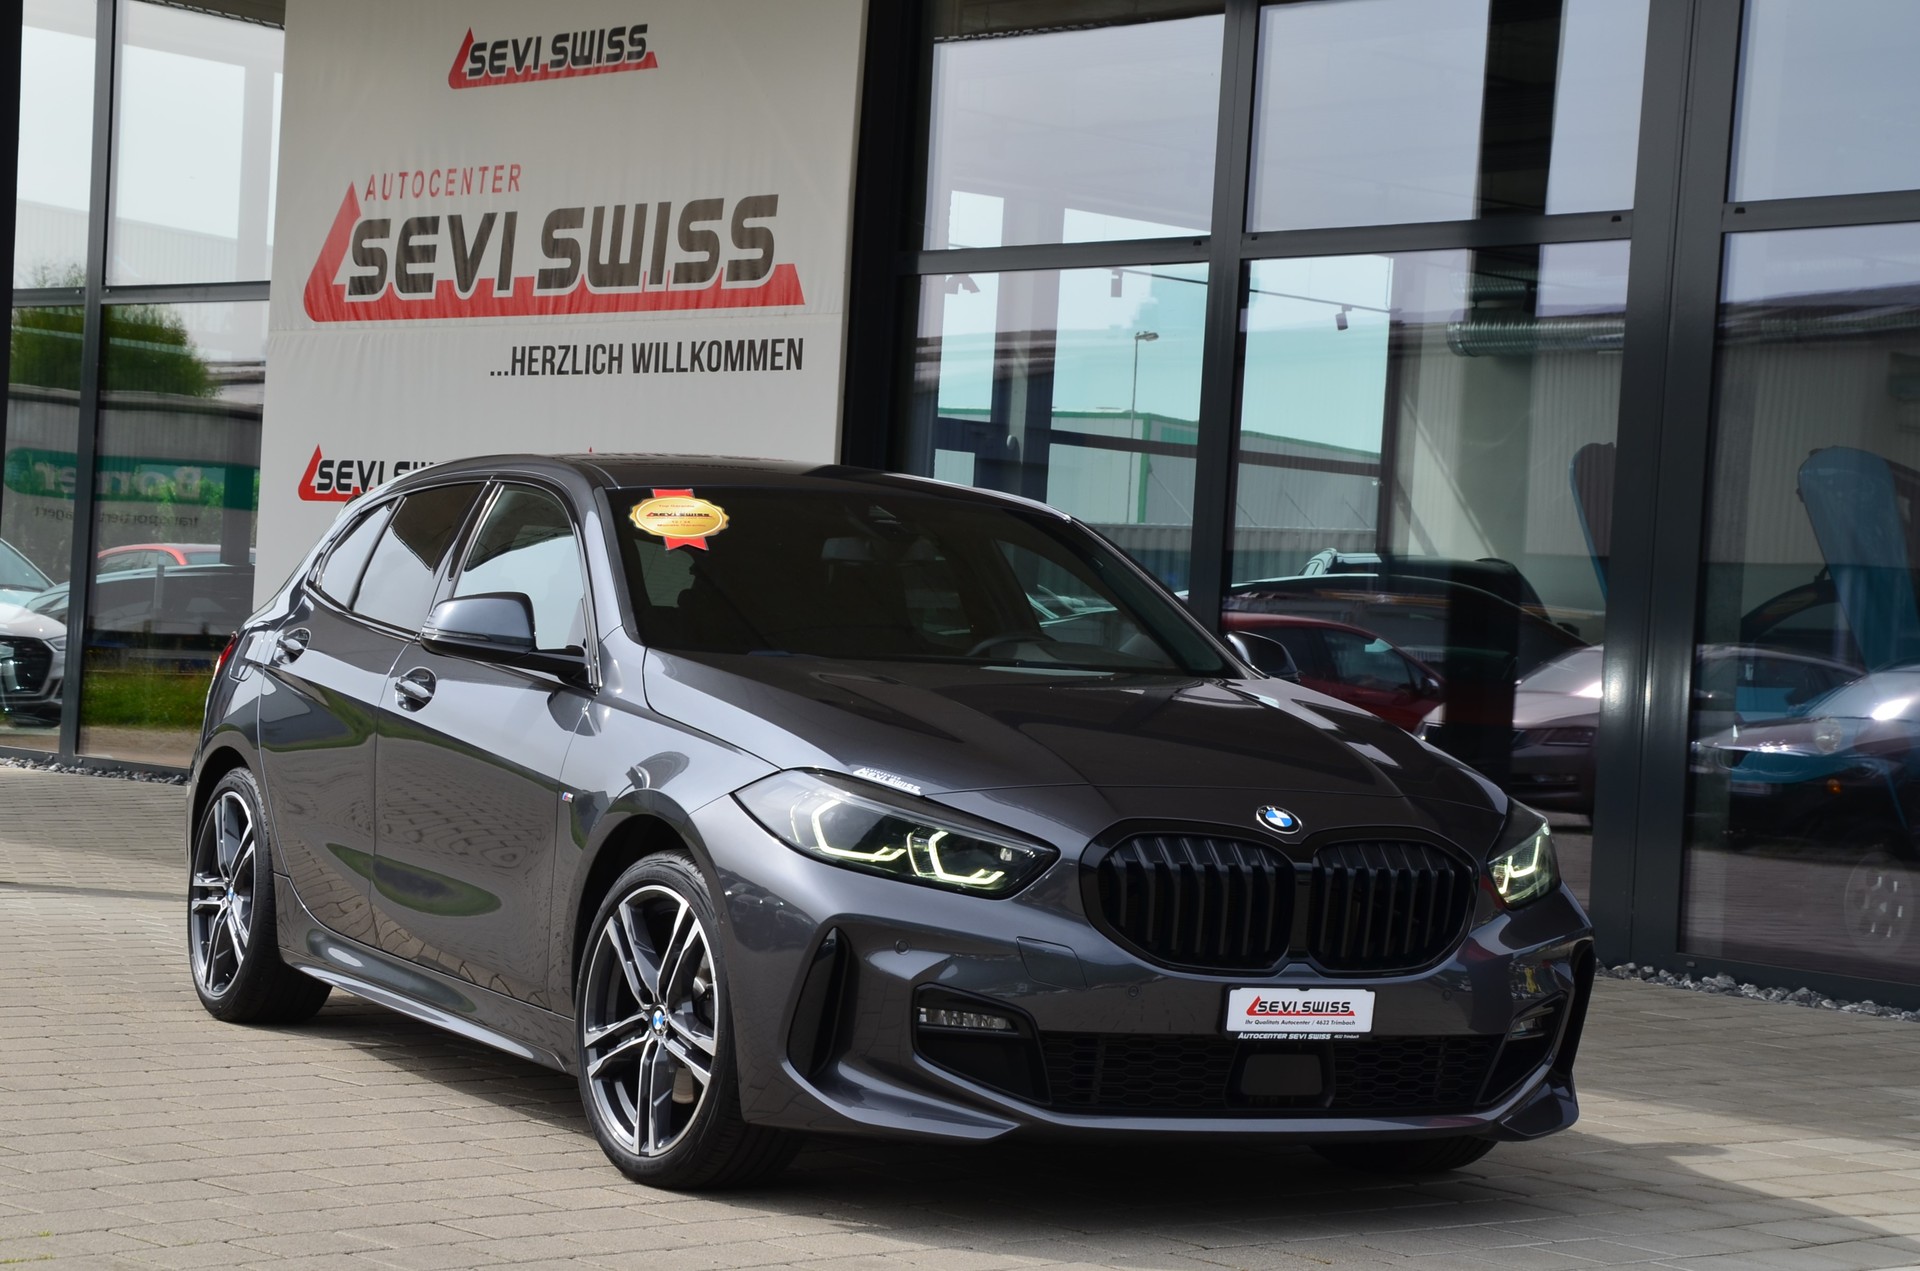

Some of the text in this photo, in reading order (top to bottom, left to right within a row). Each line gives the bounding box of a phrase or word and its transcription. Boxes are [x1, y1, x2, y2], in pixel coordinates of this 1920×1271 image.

[467, 23, 648, 77] SEVI SWISS
[364, 163, 522, 201] AUTOCENTER
[348, 194, 779, 296] SEVI SWISS
[489, 337, 804, 377] ...HERZLICH WILLKOMMEN
[316, 459, 385, 492] SEVI
[1257, 1001, 1351, 1013] SEVI SWISS
